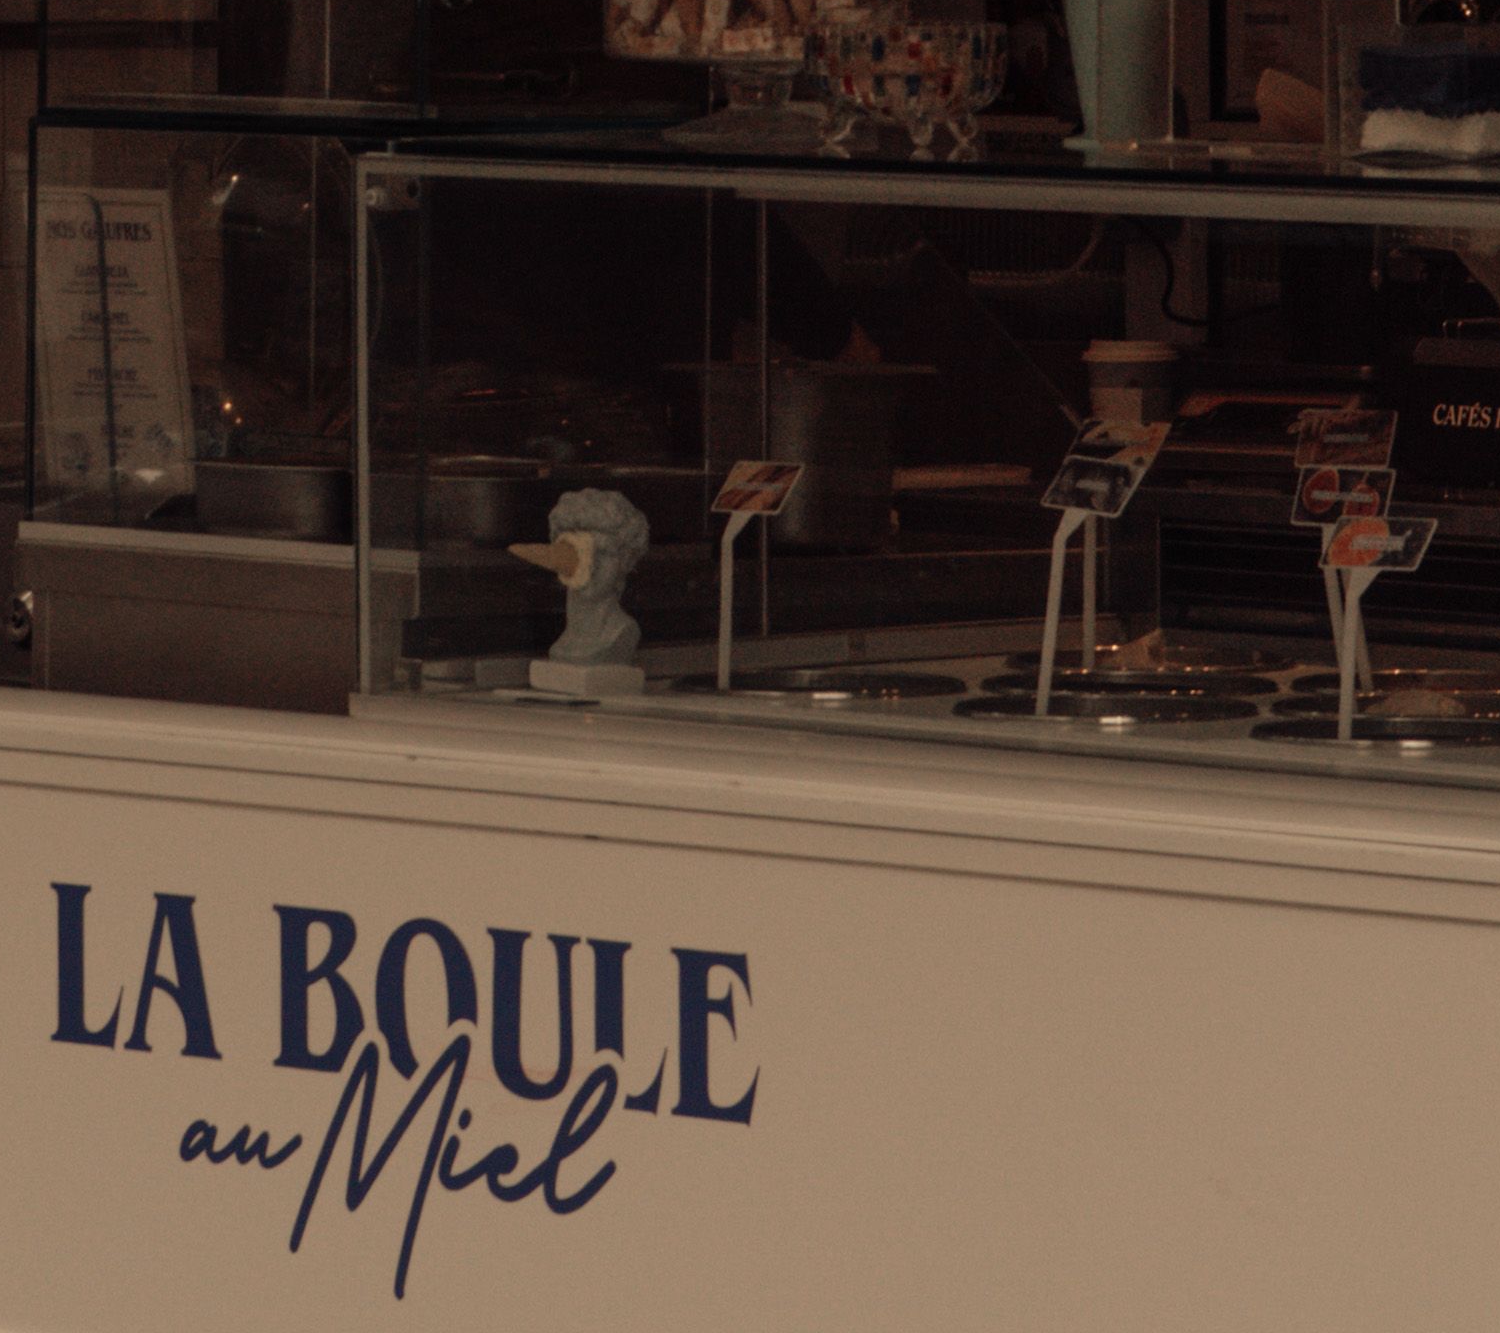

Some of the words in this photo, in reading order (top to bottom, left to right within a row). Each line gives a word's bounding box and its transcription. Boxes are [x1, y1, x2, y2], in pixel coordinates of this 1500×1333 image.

[1432, 400, 1492, 431] CAFÉS
[50, 882, 222, 1060] LA
[272, 904, 761, 1126] BOULE
[179, 1119, 303, 1169] au
[289, 1033, 618, 1300] Miel
